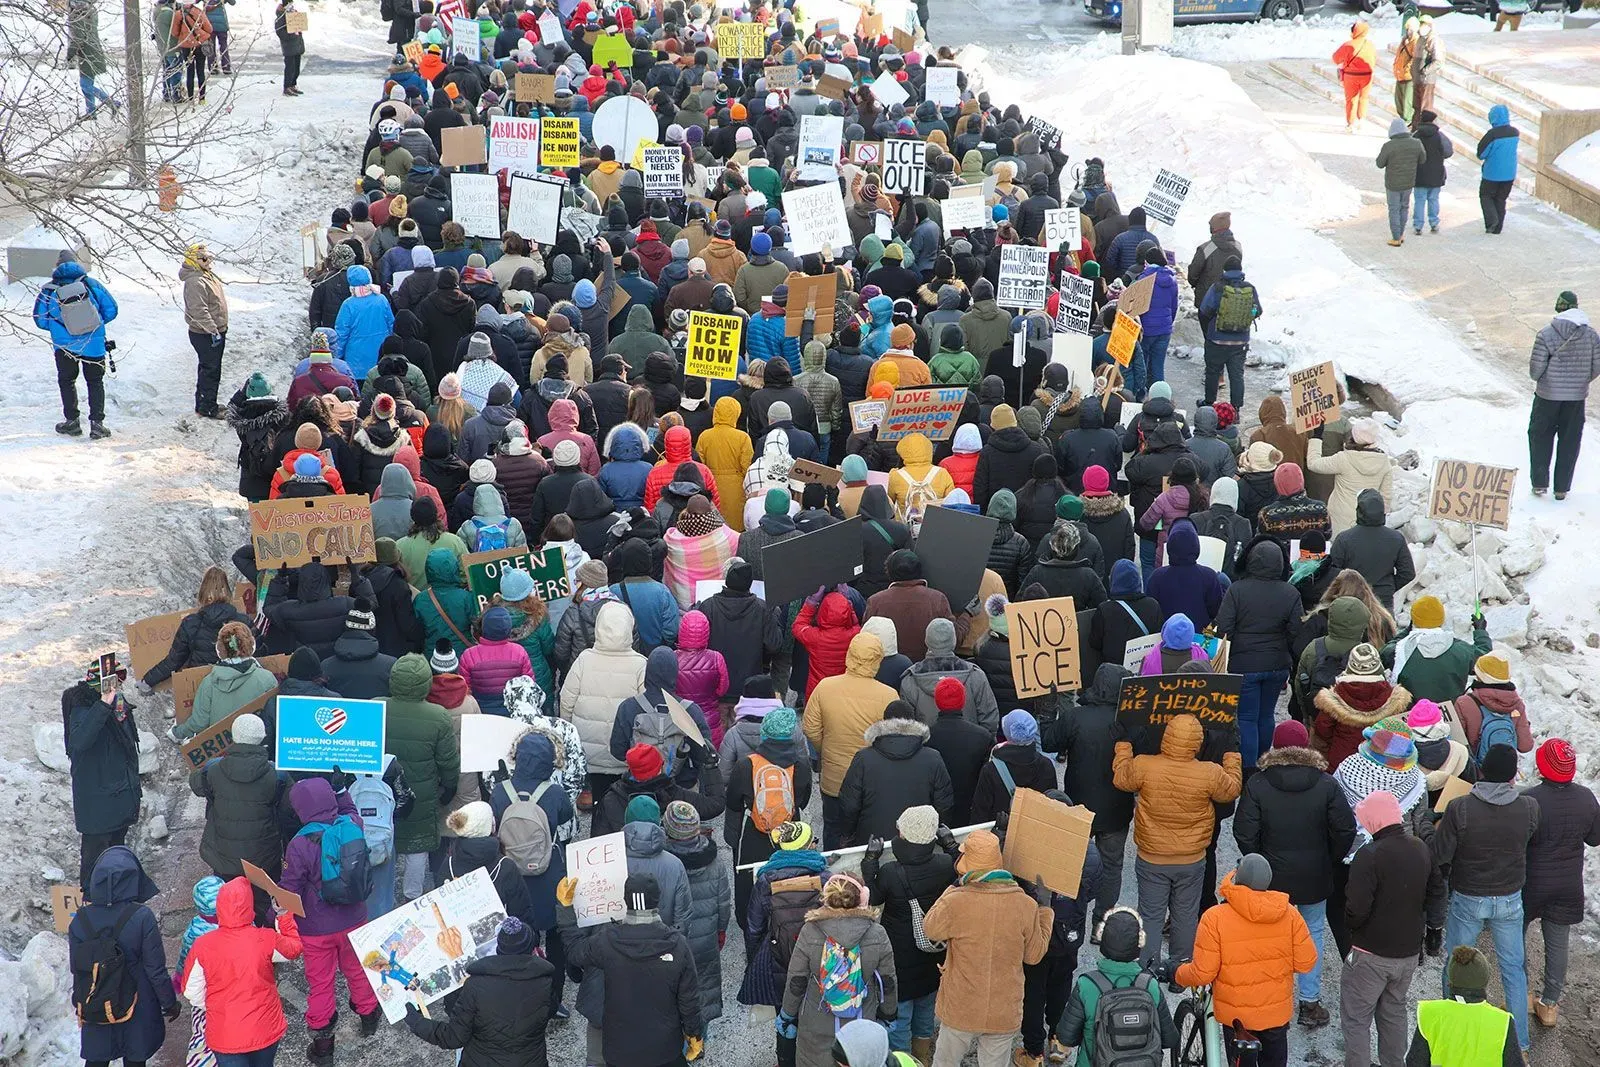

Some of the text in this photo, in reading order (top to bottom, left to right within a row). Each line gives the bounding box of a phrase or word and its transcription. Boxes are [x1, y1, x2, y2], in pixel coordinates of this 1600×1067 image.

[718, 24, 763, 37] COWARDICE
[491, 121, 537, 140] ABOLISH
[543, 120, 574, 129] DISARM
[543, 130, 577, 140] DISBAND
[1032, 126, 1046, 143] ICE
[495, 142, 529, 158] ICE
[543, 143, 578, 152] ICE NOW
[886, 140, 925, 166] ICE
[645, 155, 680, 163] PEOPLE'S
[646, 173, 681, 183] NOT THE
[884, 165, 924, 192] OUT
[1155, 174, 1189, 196] UNITED
[1159, 168, 1192, 187] THE PEOPLE
[792, 191, 835, 211] IMPEACH
[1143, 198, 1178, 218] FAMILIES!
[1148, 191, 1181, 210] IMMIGRANT
[1047, 210, 1077, 225] ICE
[1046, 226, 1078, 240] OUT
[1002, 249, 1048, 263] BALTIMORE
[1001, 264, 1047, 276] MINNEAPOLIS
[999, 277, 1046, 287] STOP
[1061, 275, 1093, 297] BALTIMORE
[999, 286, 1044, 300] ICE TERROR
[1059, 303, 1090, 319] STOP
[693, 315, 739, 330] DISBAND
[1065, 313, 1089, 332] TERROR
[695, 327, 731, 347] ICE
[692, 345, 733, 364] NOW
[696, 369, 725, 377] ASSEMBLY
[713, 365, 733, 373] POWER
[1292, 365, 1325, 385] BELIEVE
[1302, 378, 1319, 392] YOUR
[896, 389, 967, 404] LOVE THY
[1302, 387, 1323, 404] EYES
[891, 402, 964, 417] IMMIGRANT
[1296, 402, 1312, 418] NOT
[887, 412, 953, 425] NEIGHBOR
[907, 421, 928, 431] AS
[1304, 411, 1327, 429] LIES
[881, 429, 944, 440] THYF!
[794, 467, 821, 480] OUT
[1436, 460, 1514, 495] NO ONE
[1432, 490, 1508, 526] IS SAFE
[256, 523, 376, 562] NO CALLA
[484, 550, 548, 579] OPEN
[477, 576, 571, 612] BERS
[1017, 608, 1065, 650] NO
[1126, 643, 1155, 655] Give me
[1129, 658, 1143, 667] you
[1158, 679, 1208, 692] WHO
[1152, 693, 1209, 712] HELD
[1210, 691, 1240, 707] THE
[187, 729, 234, 766] BRIN
[282, 736, 378, 748] HATE HAS NO HOME HERE.
[575, 843, 616, 870] ICE
[591, 871, 600, 880] A
[413, 896, 436, 912] ICE
